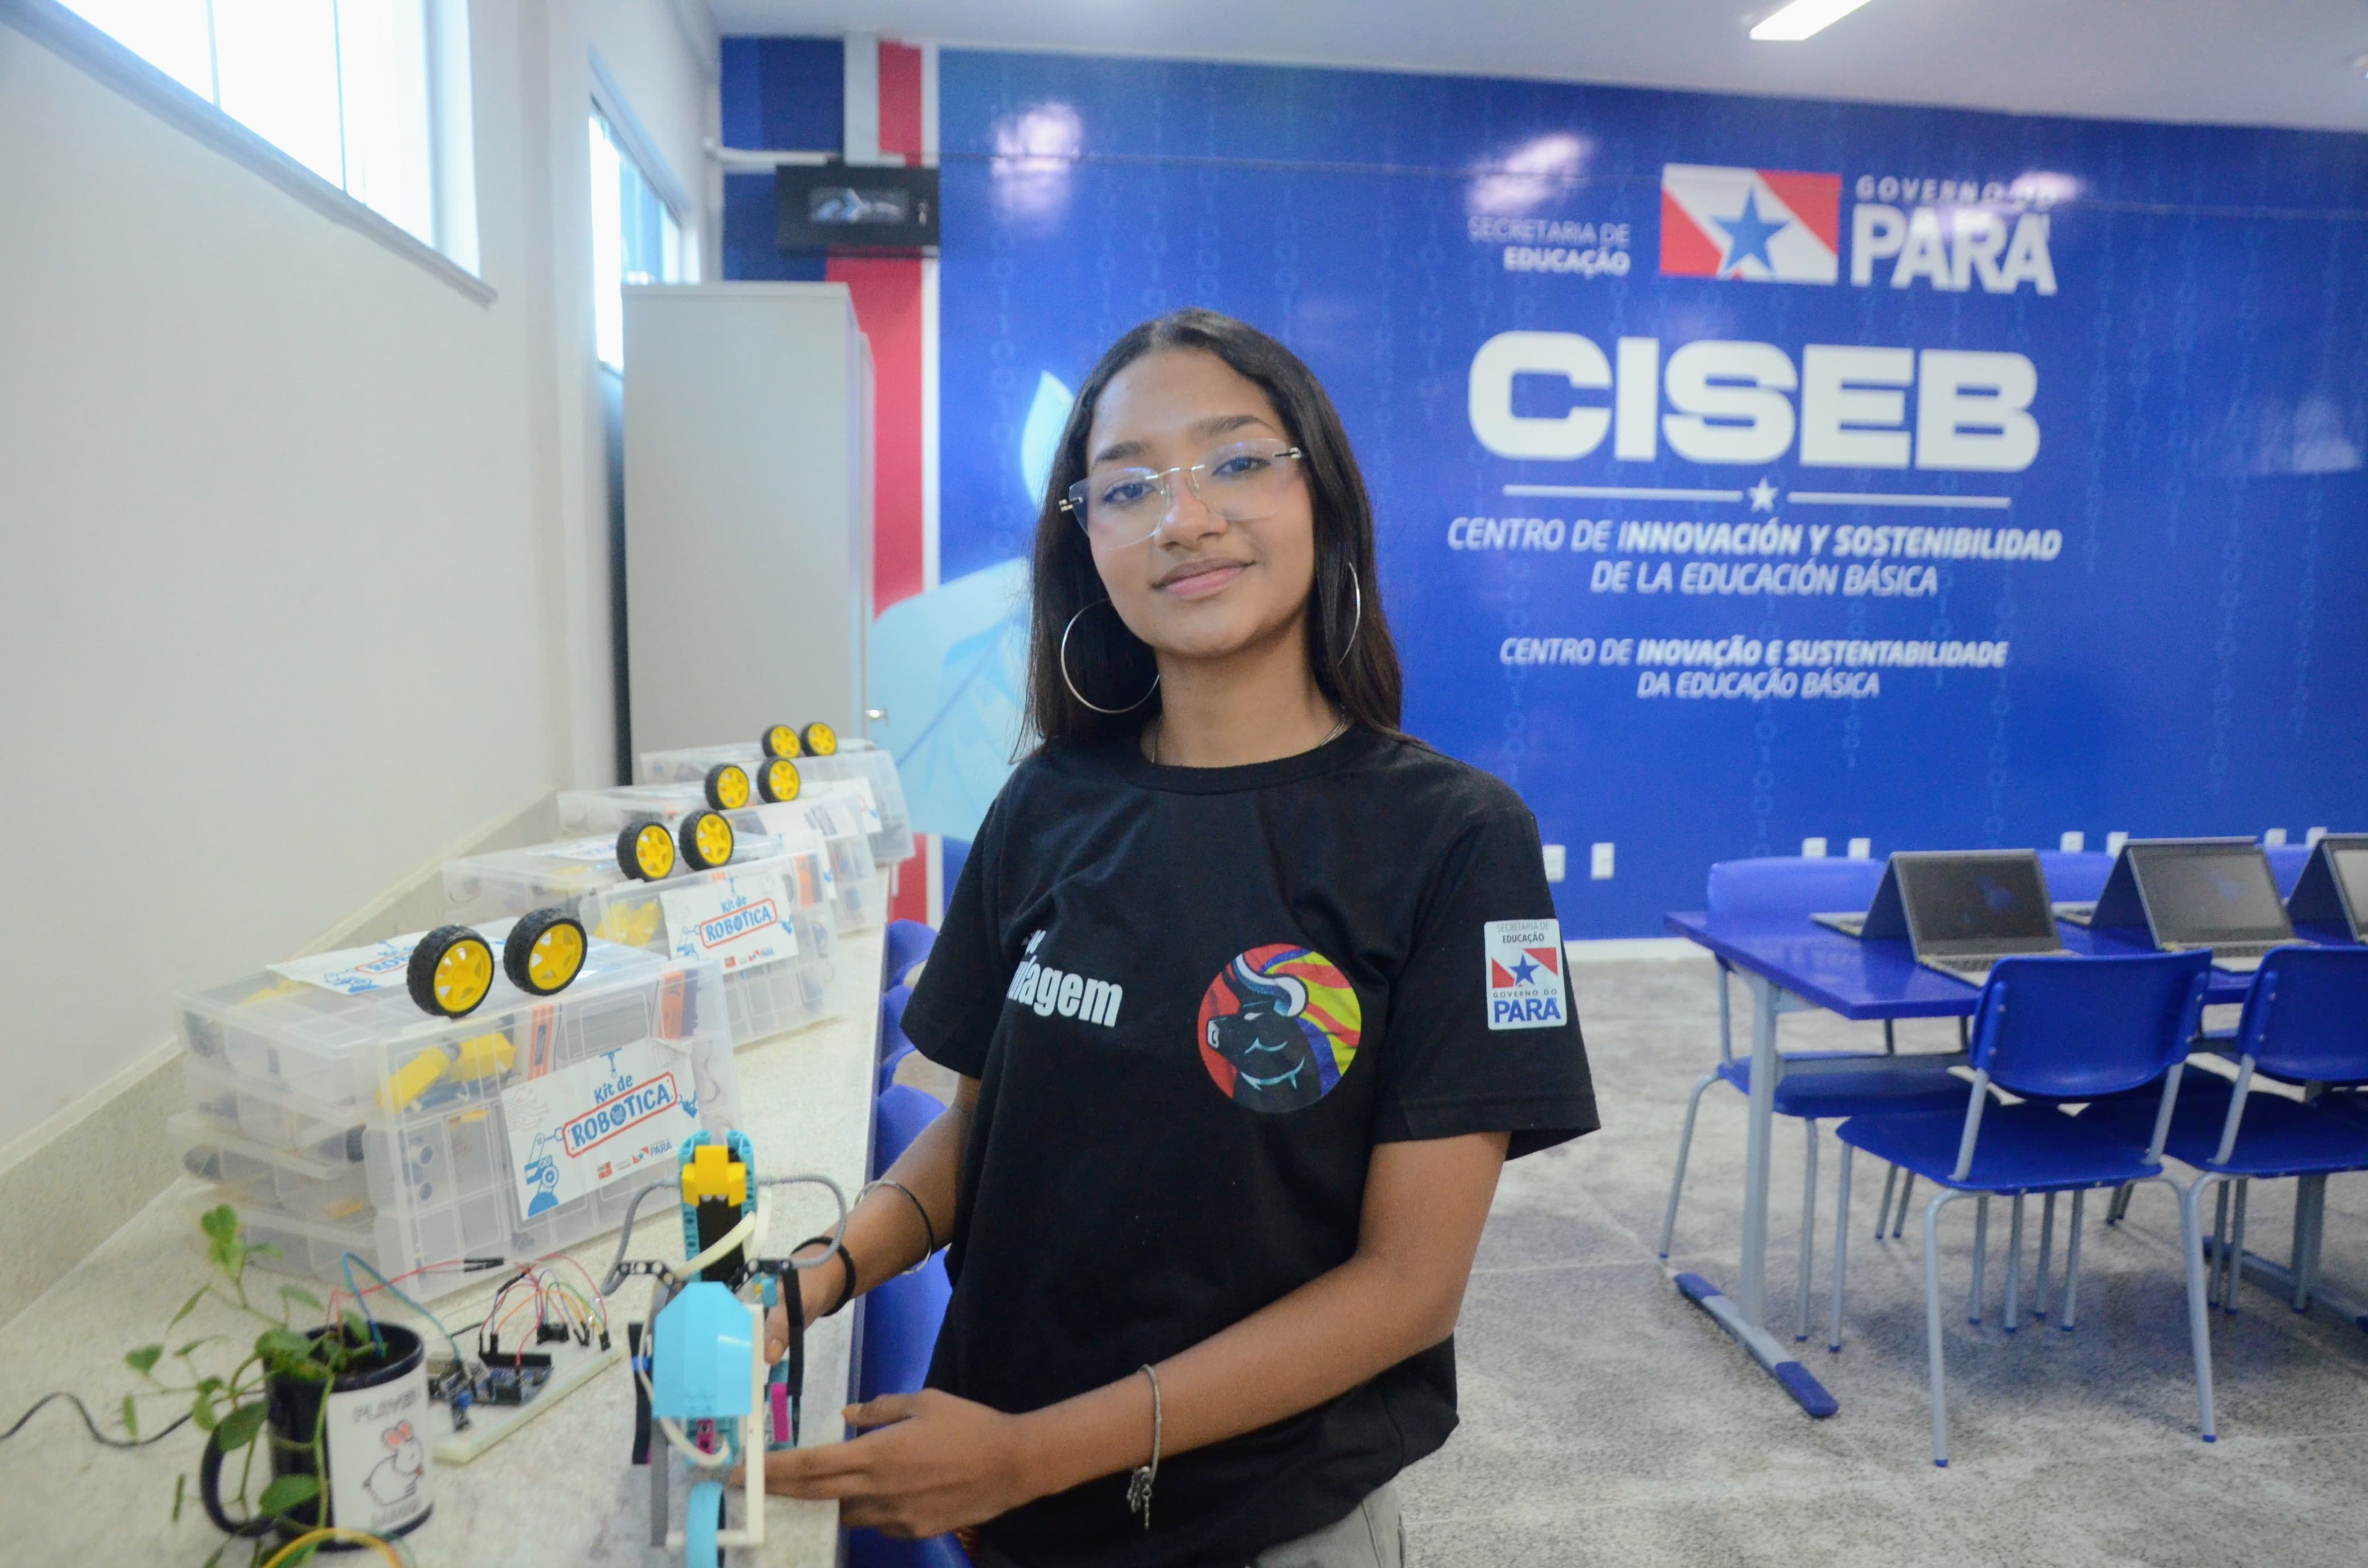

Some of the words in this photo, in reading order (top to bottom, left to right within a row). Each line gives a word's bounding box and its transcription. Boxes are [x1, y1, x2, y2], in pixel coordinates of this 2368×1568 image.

[1856, 174, 2005, 205] GOVERNO
[1467, 216, 1597, 246] SECRETARIA
[1600, 222, 1631, 249] DE
[1503, 245, 1631, 279] EDUCAÇÃO
[1851, 203, 2057, 296] PARÁ
[1468, 330, 2041, 473] CISEB
[1447, 517, 1565, 550] CENTRO
[1571, 520, 1611, 552] DE
[1616, 517, 1803, 556] INNOVACIÓN
[1807, 525, 1832, 557] Y
[1832, 525, 2063, 561] SOSTENIBILIDAD
[1590, 561, 1631, 593] DE
[1637, 562, 1673, 594] LA
[1680, 558, 1837, 596] EDUCACIÓN
[1843, 558, 1938, 598] BÁSICA
[1500, 637, 1596, 666] CENTRO
[1599, 638, 1631, 666] DE
[1636, 634, 1761, 672] INOVAÇÃO
[1764, 640, 1782, 666] E
[1785, 639, 2010, 668] SUSTENTABILIDADE
[1636, 670, 1670, 698] DA
[1675, 667, 1798, 703] EDUCAÇÃO
[1800, 667, 1881, 700] BÁSICA
[720, 899, 735, 913] Kit
[735, 895, 747, 907] de
[1497, 921, 1539, 932] SECRETARIA
[1540, 921, 1549, 931] DE
[1502, 932, 1545, 944] EDUCAÇÃO
[1493, 990, 1539, 998] GOVERNO
[1494, 997, 1561, 1023] PARÁ
[594, 1082, 615, 1104] Kit
[618, 1075, 634, 1092] de
[571, 1083, 671, 1147] ROBOTICA
